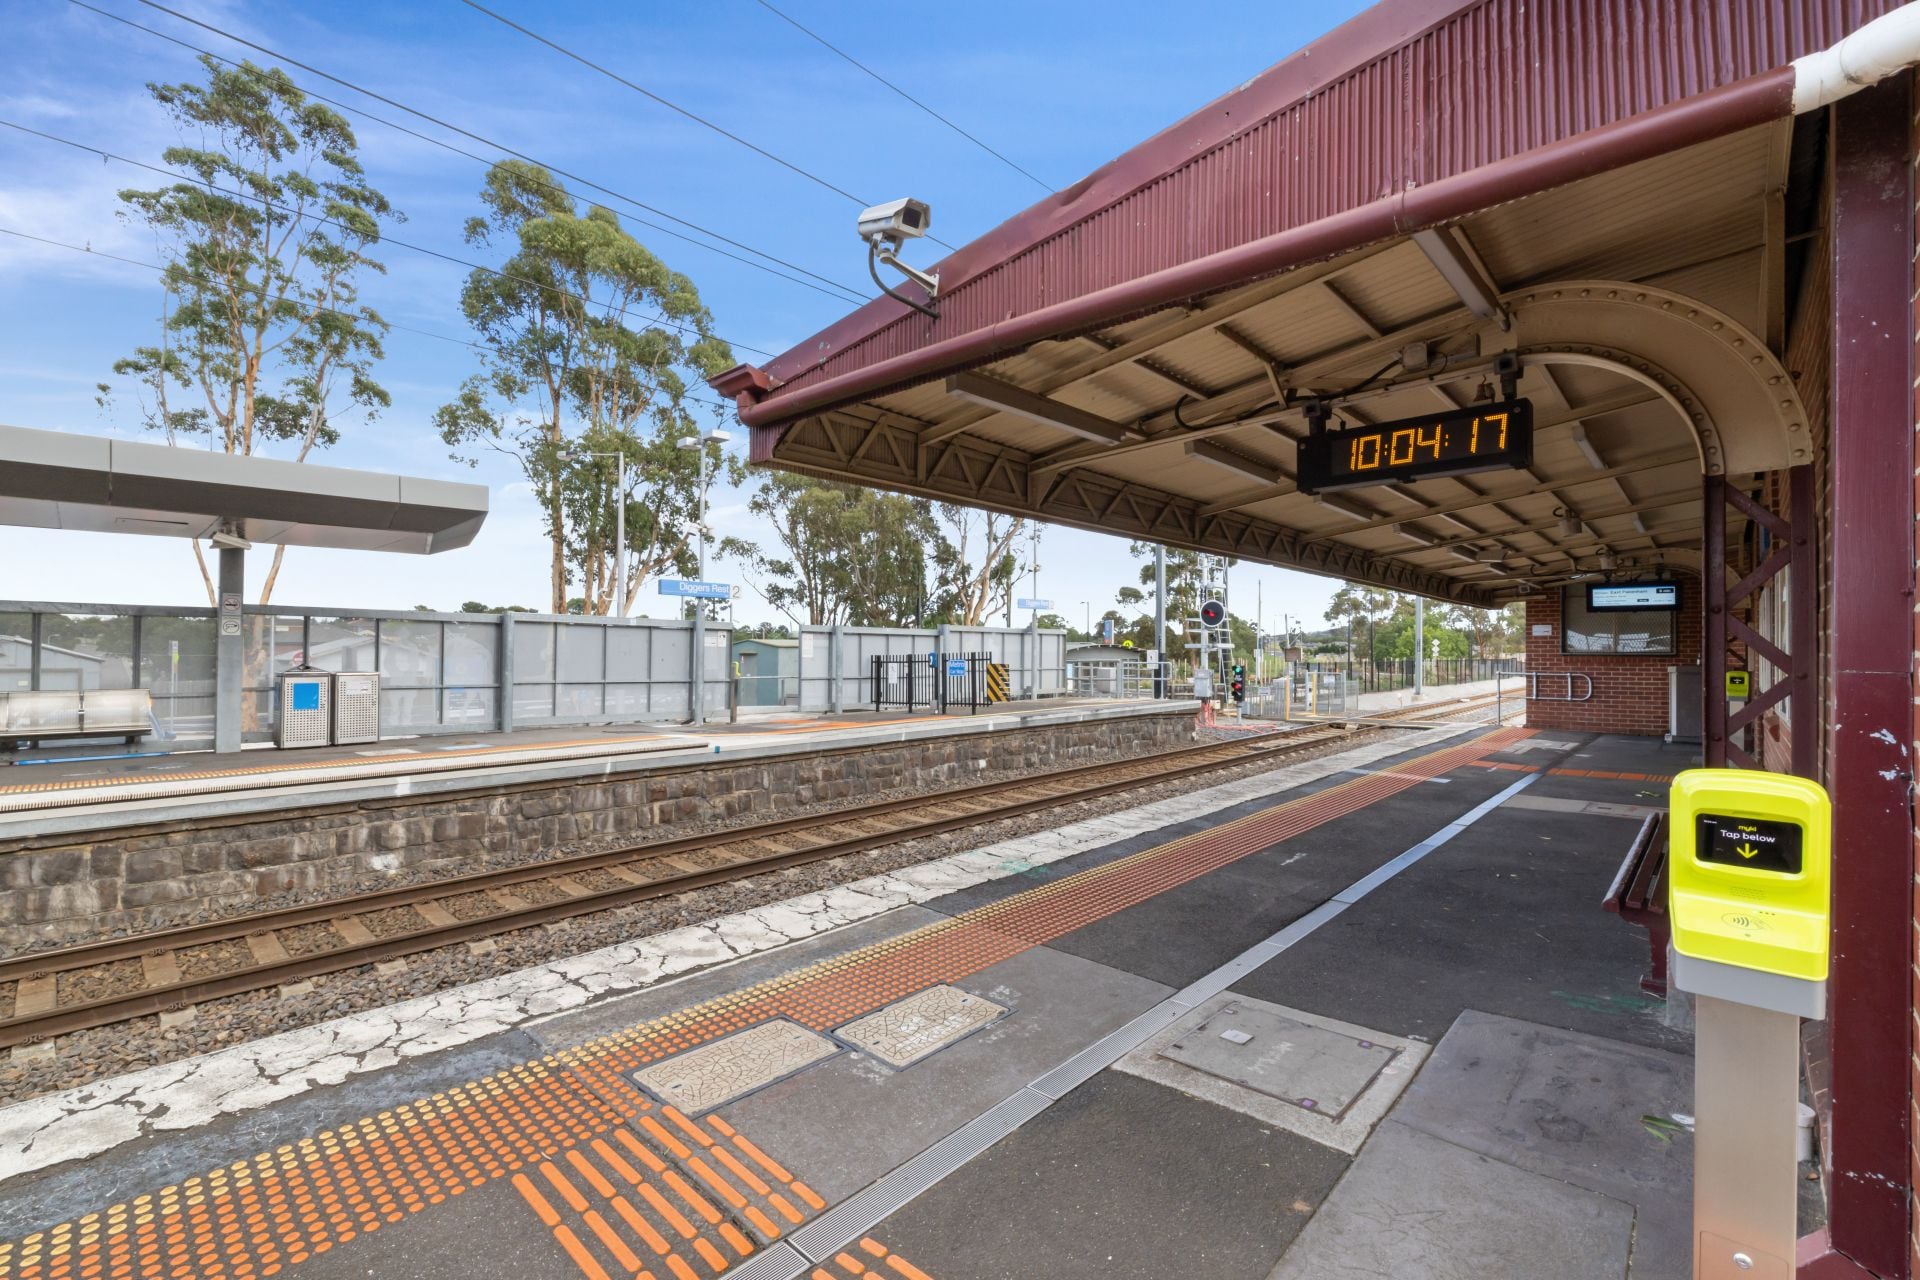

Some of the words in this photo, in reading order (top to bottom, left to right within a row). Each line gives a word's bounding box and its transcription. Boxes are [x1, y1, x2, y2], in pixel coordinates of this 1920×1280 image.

[679, 582, 710, 594] Diggers
[711, 584, 729, 593] Rest
[732, 585, 740, 598] 2
[1720, 829, 1741, 840] Tap
[1742, 833, 1776, 843] below
